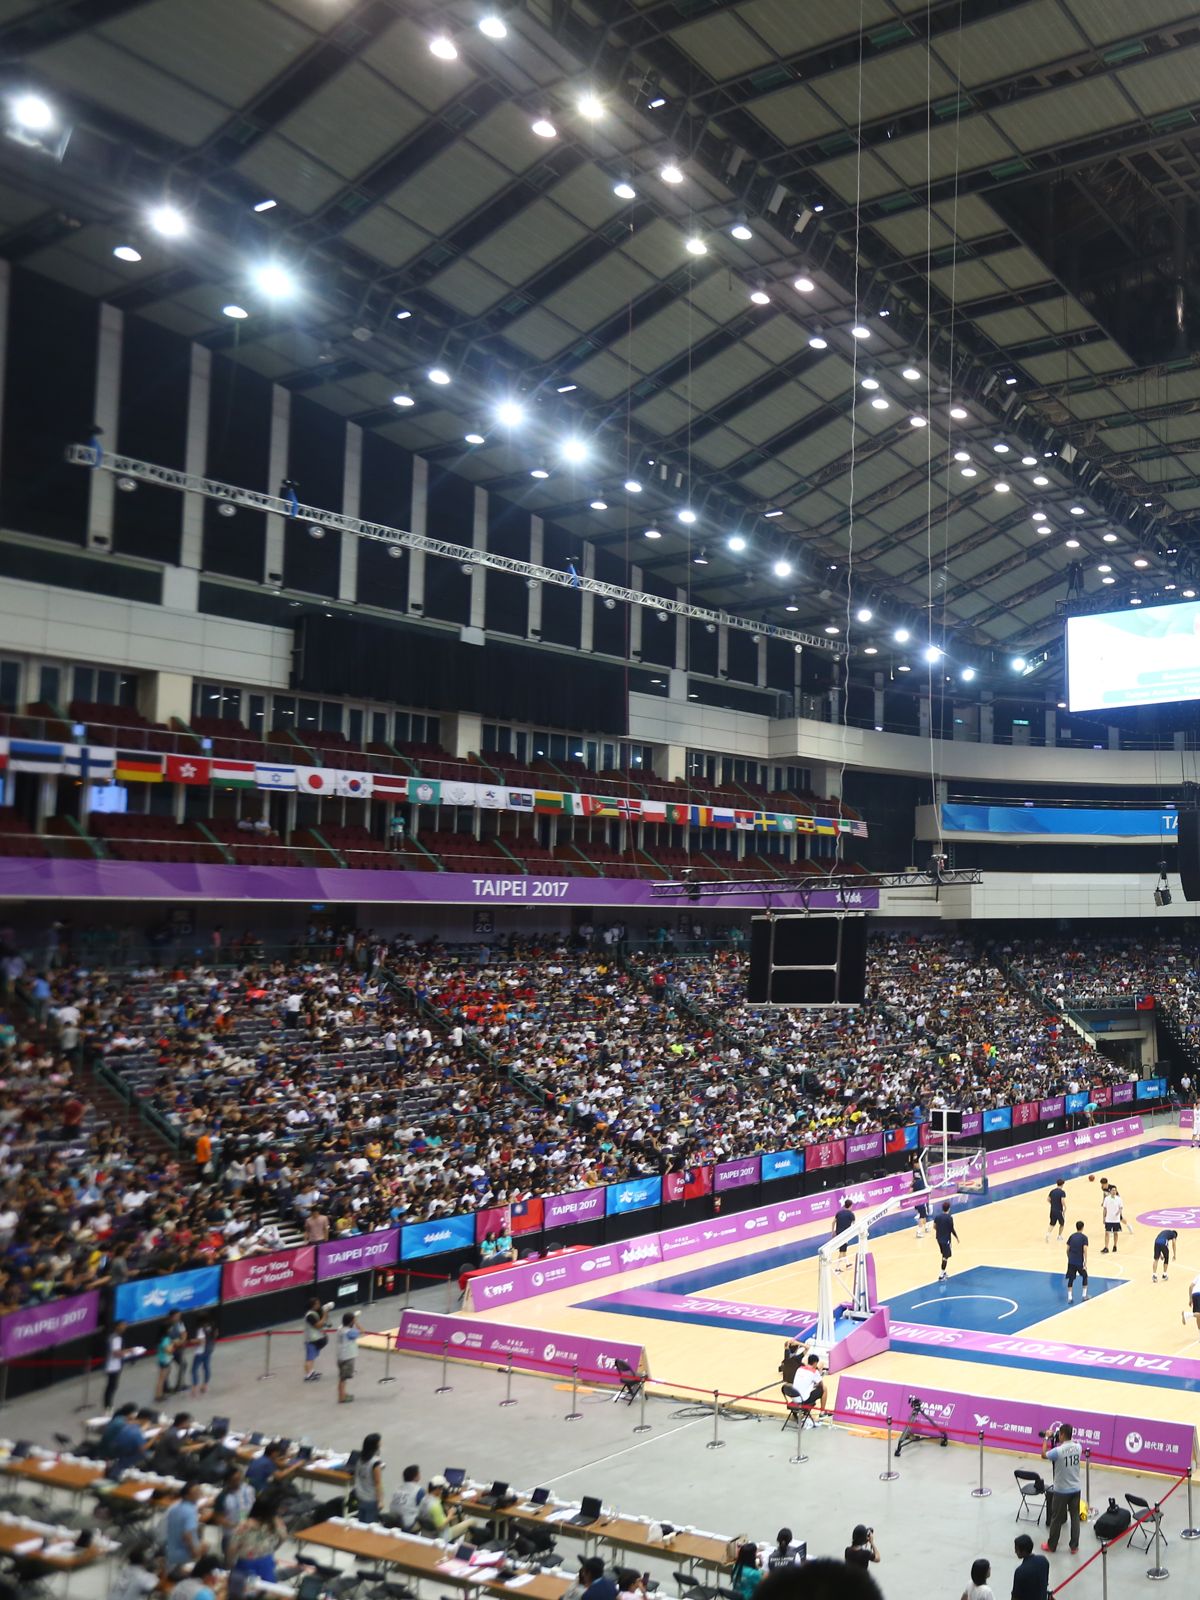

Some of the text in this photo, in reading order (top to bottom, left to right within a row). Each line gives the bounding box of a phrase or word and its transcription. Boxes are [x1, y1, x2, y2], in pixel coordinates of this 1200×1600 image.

[472, 879, 569, 897] TAIPEI 2017
[850, 1141, 879, 1153] TAIPEI 2017
[719, 1166, 755, 1181] TAIPEI 2017
[867, 1188, 882, 1197] TAIPEI
[551, 1199, 598, 1216] TAIPEI 2017
[328, 1242, 390, 1265] TAIPEI 2017
[249, 1260, 289, 1276] For You
[243, 1270, 294, 1288] For Youth
[672, 1299, 819, 1325] NIVERSIADE
[13, 1307, 89, 1340] TAIPEI 2017
[986, 1339, 1059, 1357] 2017
[1067, 1348, 1173, 1372] TAIPEI
[844, 1396, 889, 1416] SPALDING
[1064, 1454, 1080, 1468] 118
